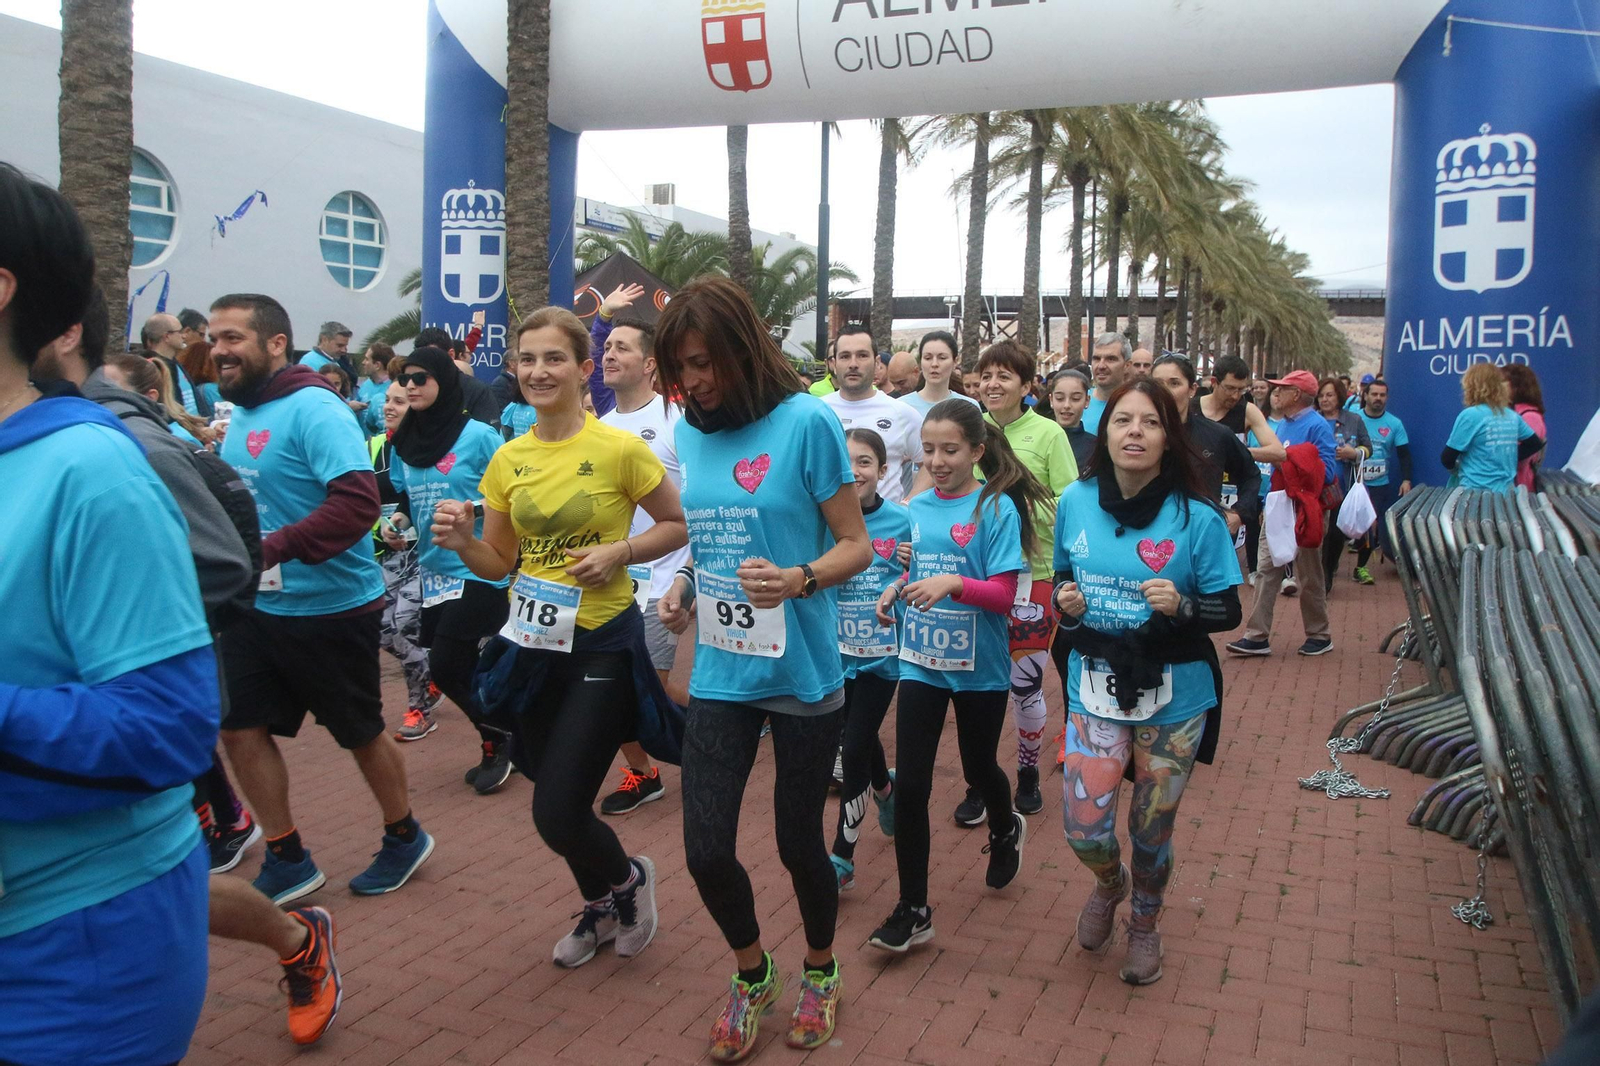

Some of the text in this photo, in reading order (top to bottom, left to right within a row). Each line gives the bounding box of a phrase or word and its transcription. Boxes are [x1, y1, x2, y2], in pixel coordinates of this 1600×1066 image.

[834, 26, 993, 72] CIUDAD
[1398, 306, 1574, 352] ALMERÍA
[719, 506, 758, 519] Fashion
[726, 519, 746, 533] azul
[702, 533, 714, 545] el
[715, 531, 752, 546] autismo
[1070, 545, 1089, 554] ALTEA
[940, 553, 967, 564] Fashion
[864, 566, 889, 574] ashion
[942, 563, 957, 571] azul
[1081, 570, 1116, 585] Runner
[1119, 577, 1142, 590] Fash
[1080, 583, 1142, 600] Carrera azul
[517, 595, 558, 627] 718
[1091, 597, 1102, 608] el
[1104, 599, 1145, 611] autismo
[716, 601, 755, 629] 93
[907, 621, 969, 650] 1103
